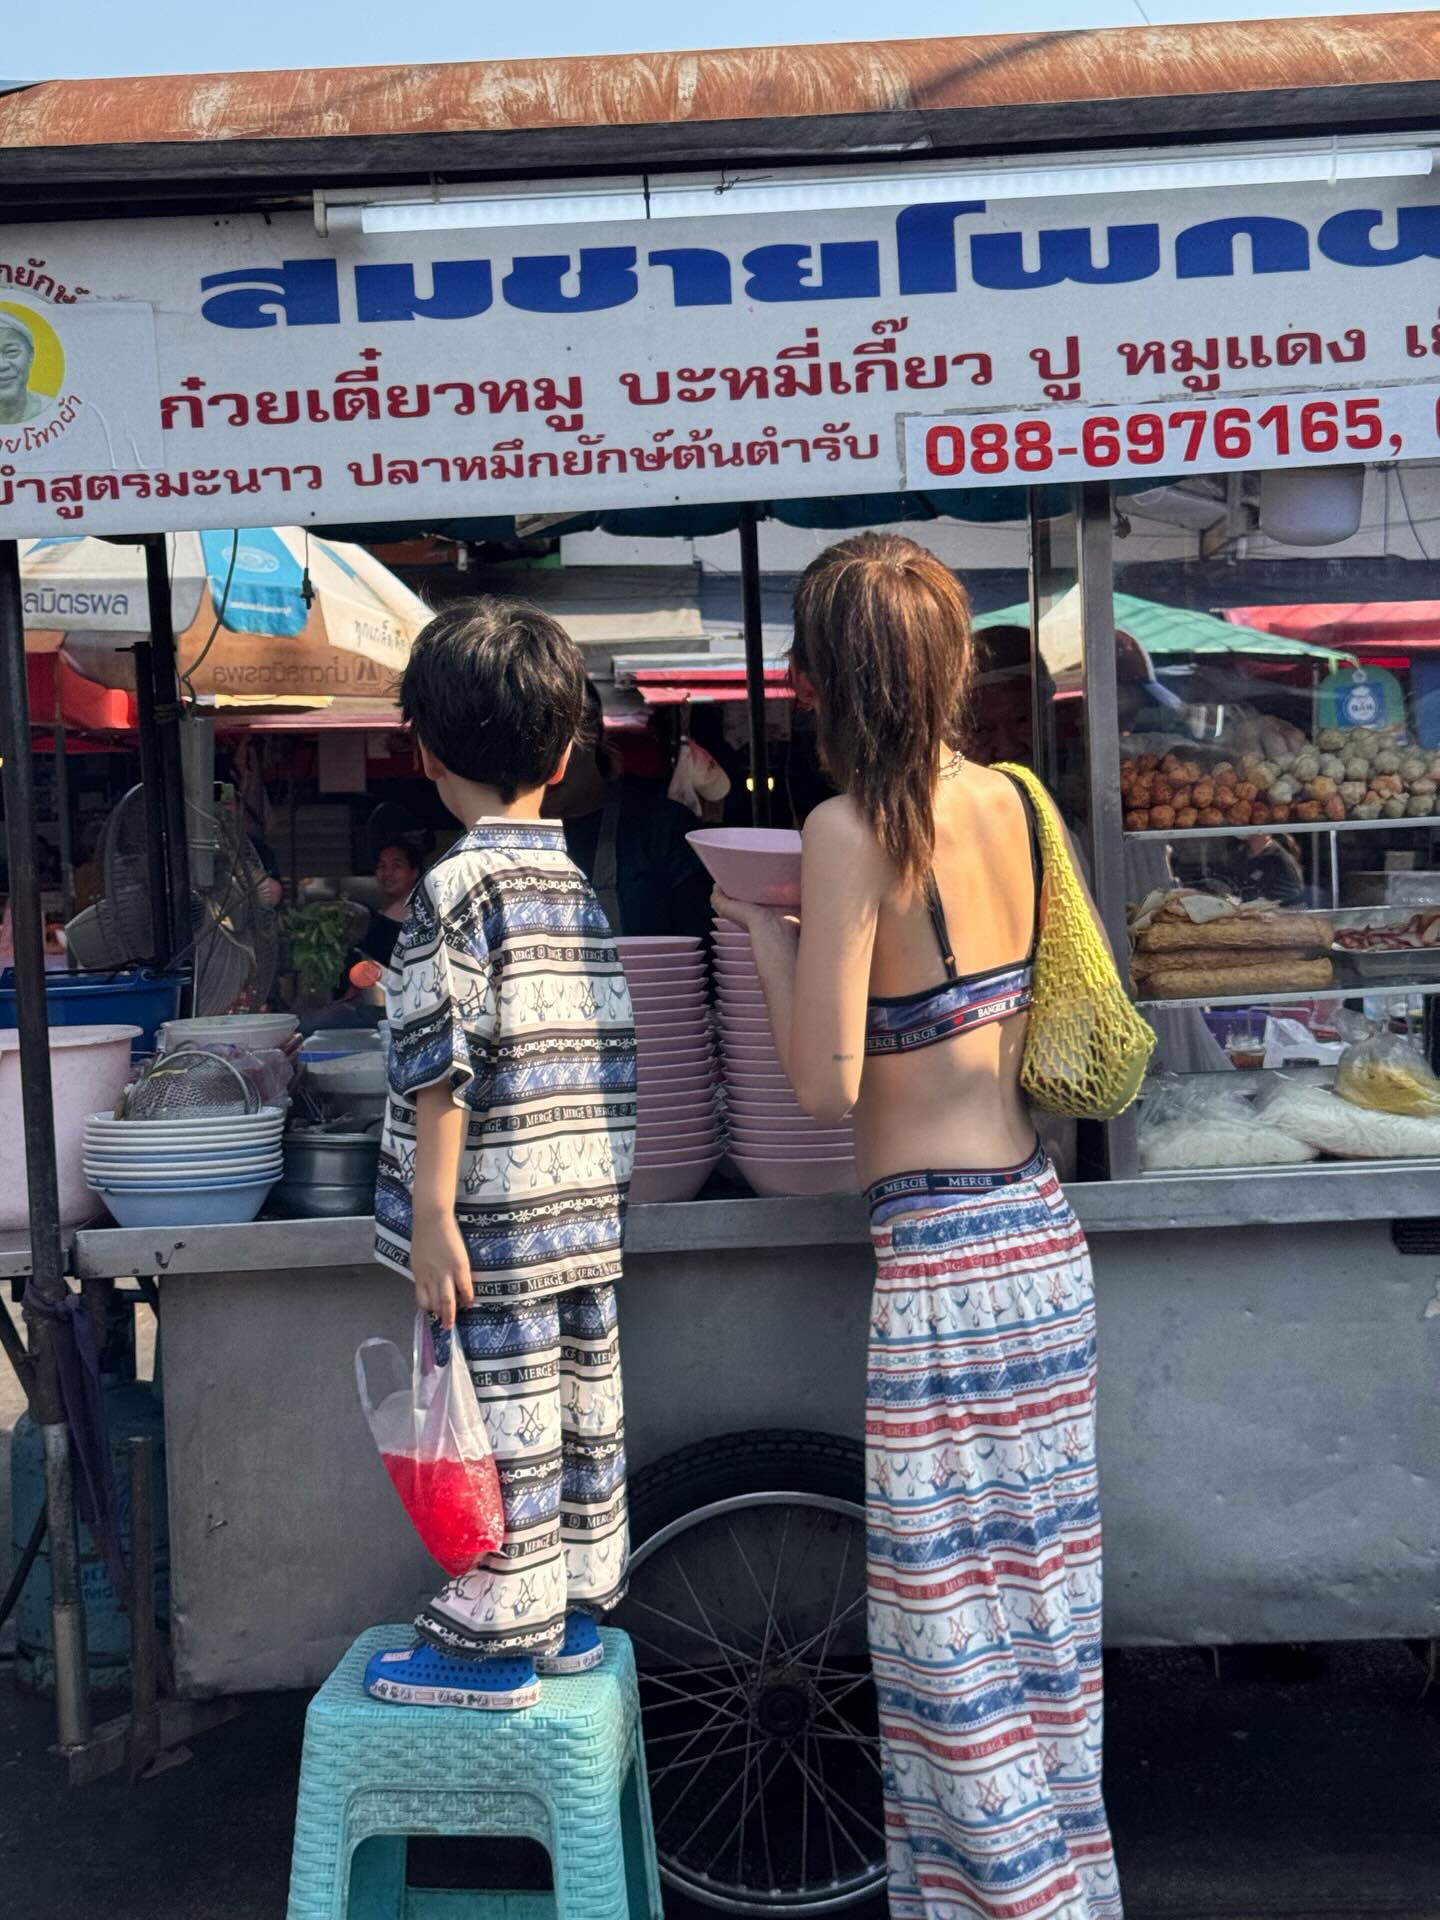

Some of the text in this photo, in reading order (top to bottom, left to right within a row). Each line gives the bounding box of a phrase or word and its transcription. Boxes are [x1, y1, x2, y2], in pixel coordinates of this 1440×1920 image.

[160, 347, 584, 432] ก๋วยเตี๋ยวหมู
[619, 316, 992, 405] บะหมี่เกี๊ยว
[1030, 336, 1081, 400] ปู
[1117, 328, 1366, 392] หมูแดง
[925, 398, 1403, 477] 088-6976165,
[348, 421, 879, 487] ปลาหมึกยักษ์ต้นตำรับ
[525, 1108, 553, 1127] MERGE
[883, 1176, 993, 1194] MERGE MERGE
[527, 1272, 565, 1293] MERGE
[517, 1363, 553, 1383] MERGE
